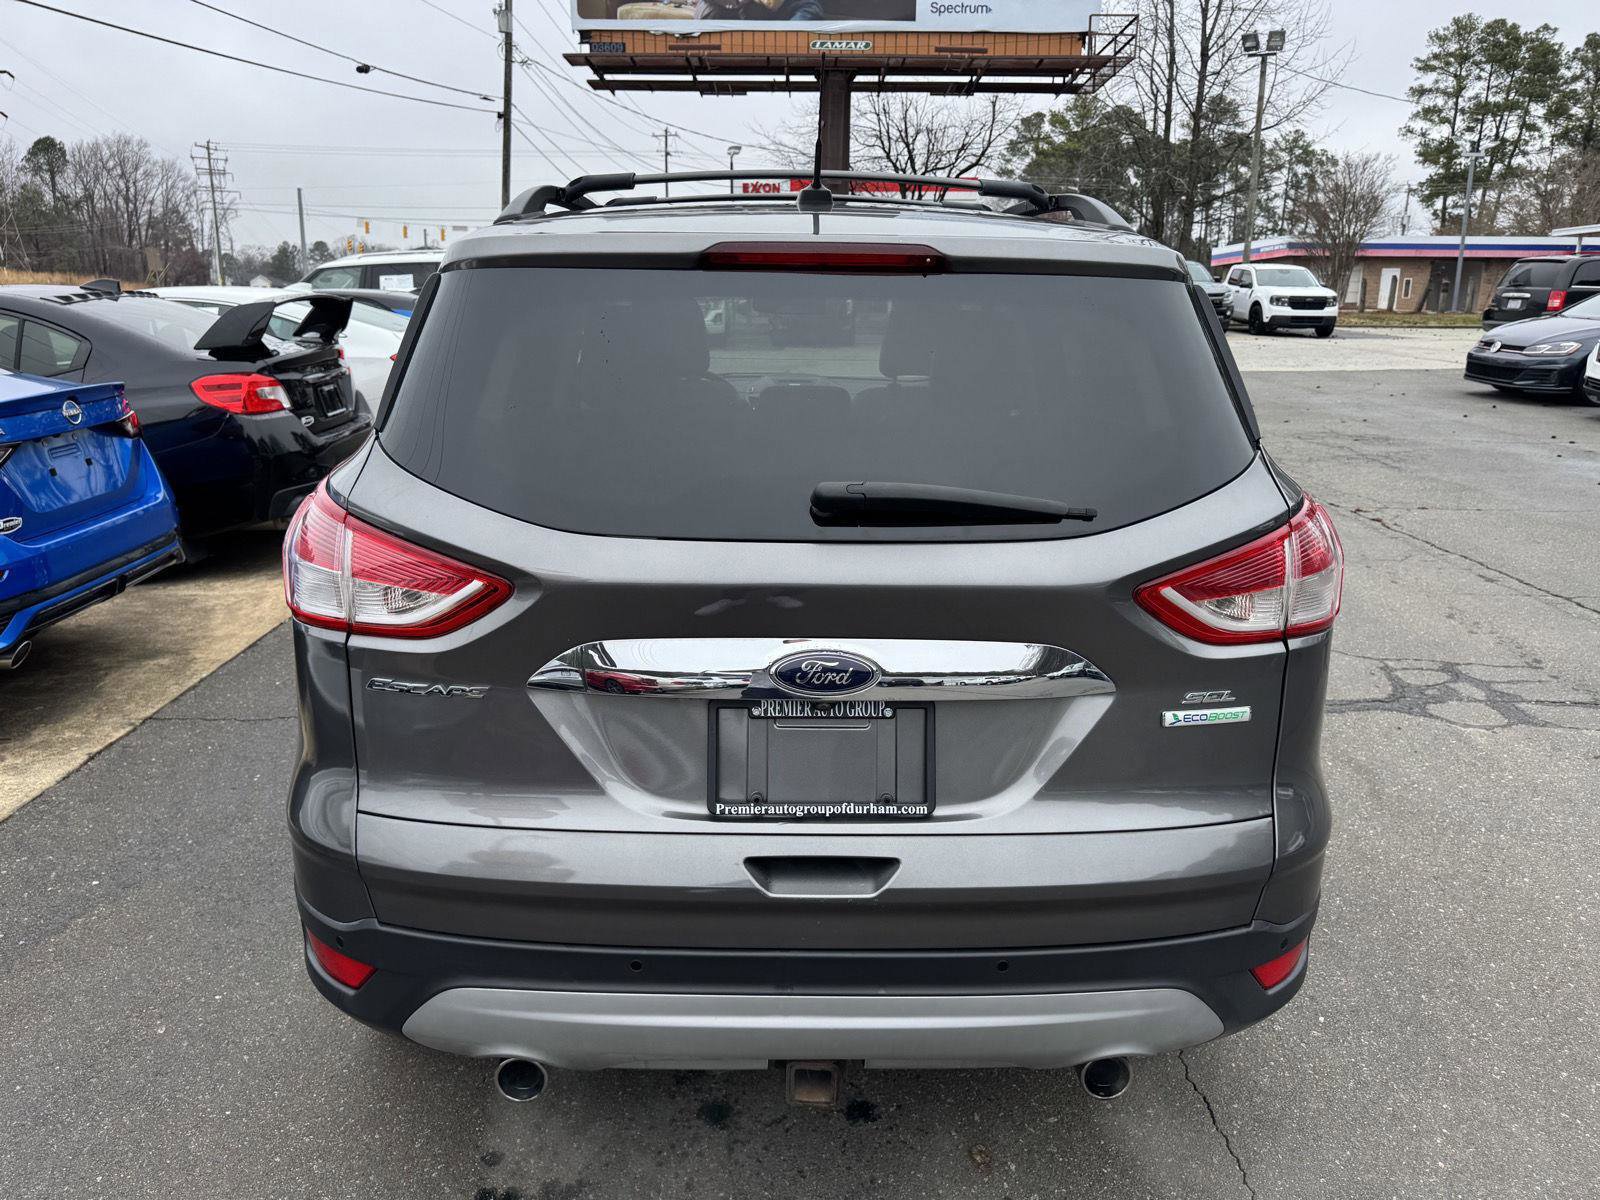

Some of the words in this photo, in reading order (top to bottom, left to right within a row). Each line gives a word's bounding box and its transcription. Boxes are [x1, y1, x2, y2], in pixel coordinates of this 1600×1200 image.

[930, 2, 988, 16] Spectrum
[592, 43, 624, 52] 03609
[815, 41, 867, 49] LAMAR
[742, 181, 780, 194] EXXON
[795, 660, 854, 685] Ford
[366, 677, 490, 699] ESCAPE
[1181, 690, 1237, 704] SEL
[761, 700, 811, 718] PREMIER
[846, 701, 886, 718] GROUP
[1182, 710, 1248, 723] ECOBOOST
[715, 803, 928, 817] Premierautogroupofdurham.com
